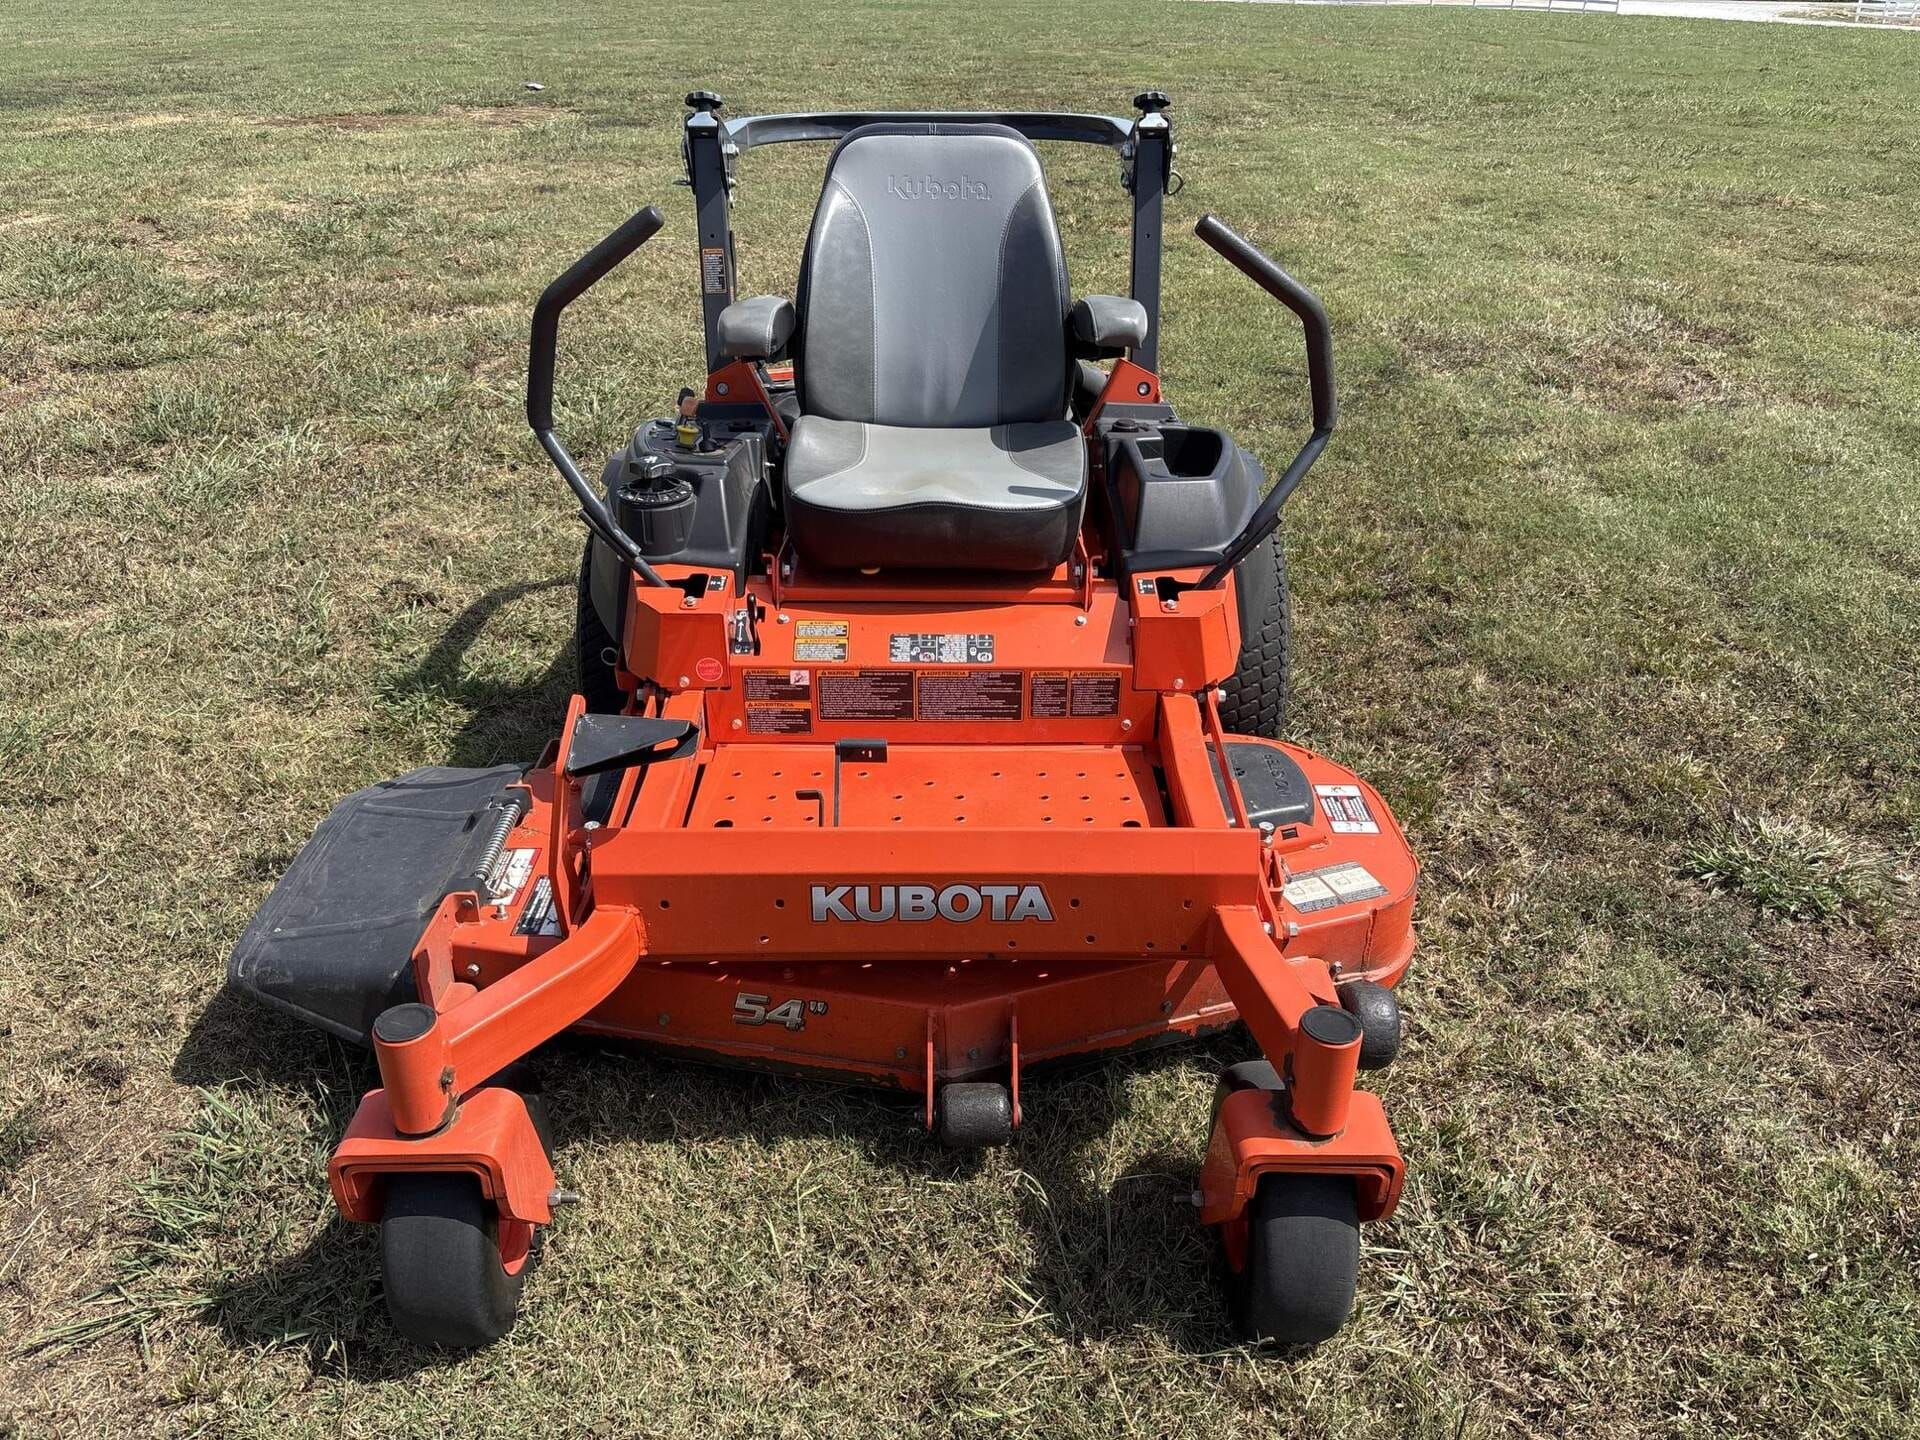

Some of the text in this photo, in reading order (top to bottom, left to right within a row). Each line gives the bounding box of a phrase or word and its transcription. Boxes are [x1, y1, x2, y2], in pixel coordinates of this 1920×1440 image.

[887, 174, 990, 200] Kubota
[810, 884, 1055, 922] KUBOTA
[732, 991, 828, 1031] 54"
